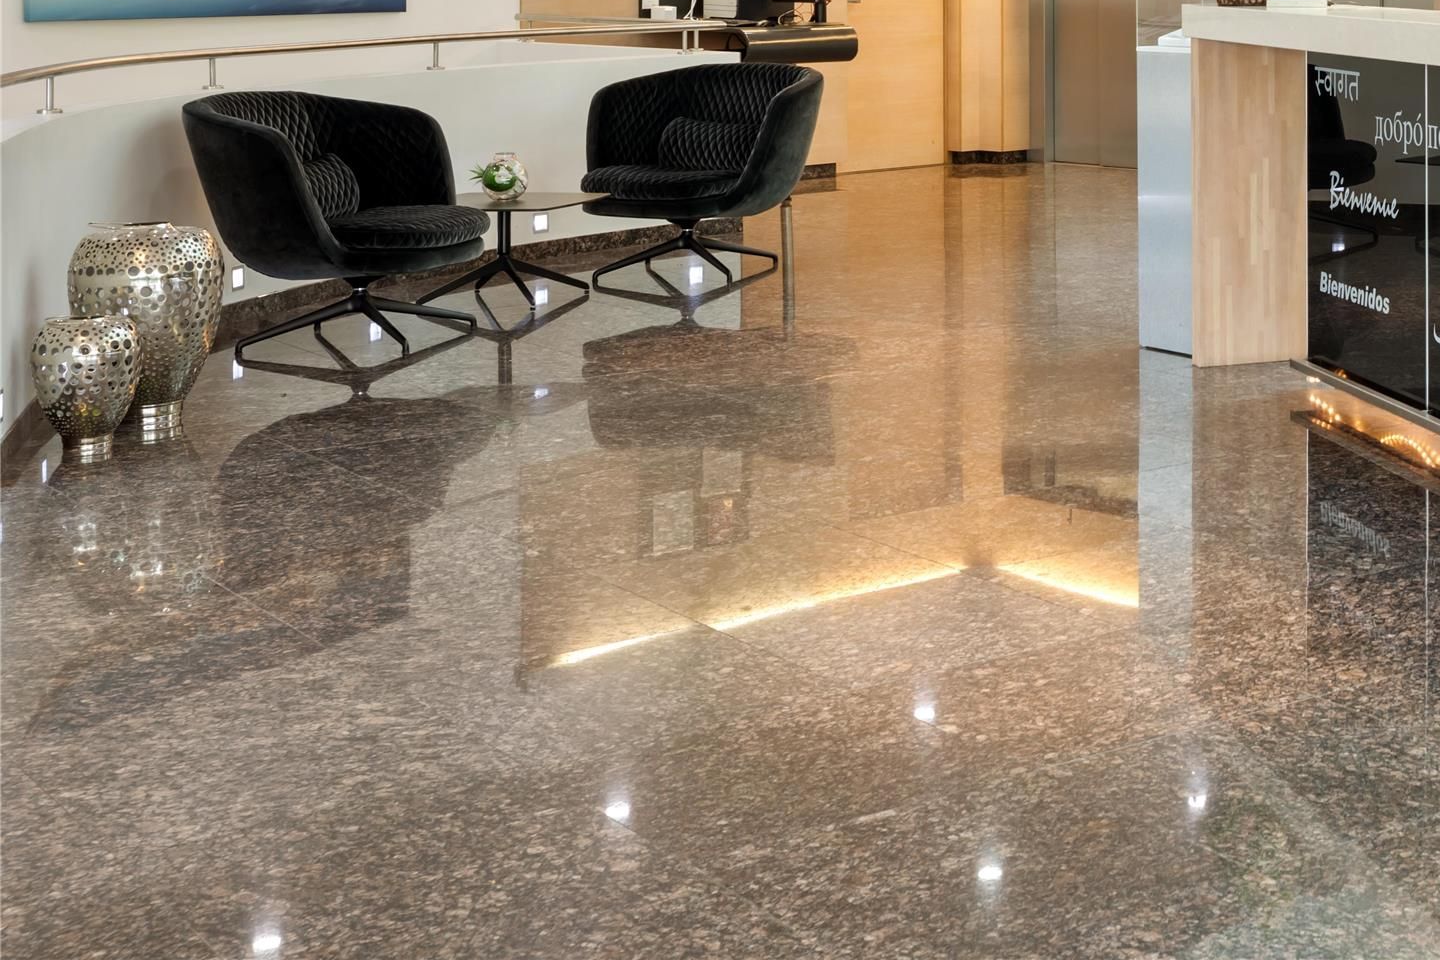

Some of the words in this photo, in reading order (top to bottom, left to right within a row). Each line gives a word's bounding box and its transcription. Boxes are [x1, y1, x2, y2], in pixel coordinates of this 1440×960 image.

[1314, 66, 1361, 102] स्वागत
[1329, 170, 1400, 220] Bienvenue
[1319, 271, 1390, 315] Bienvenidos
